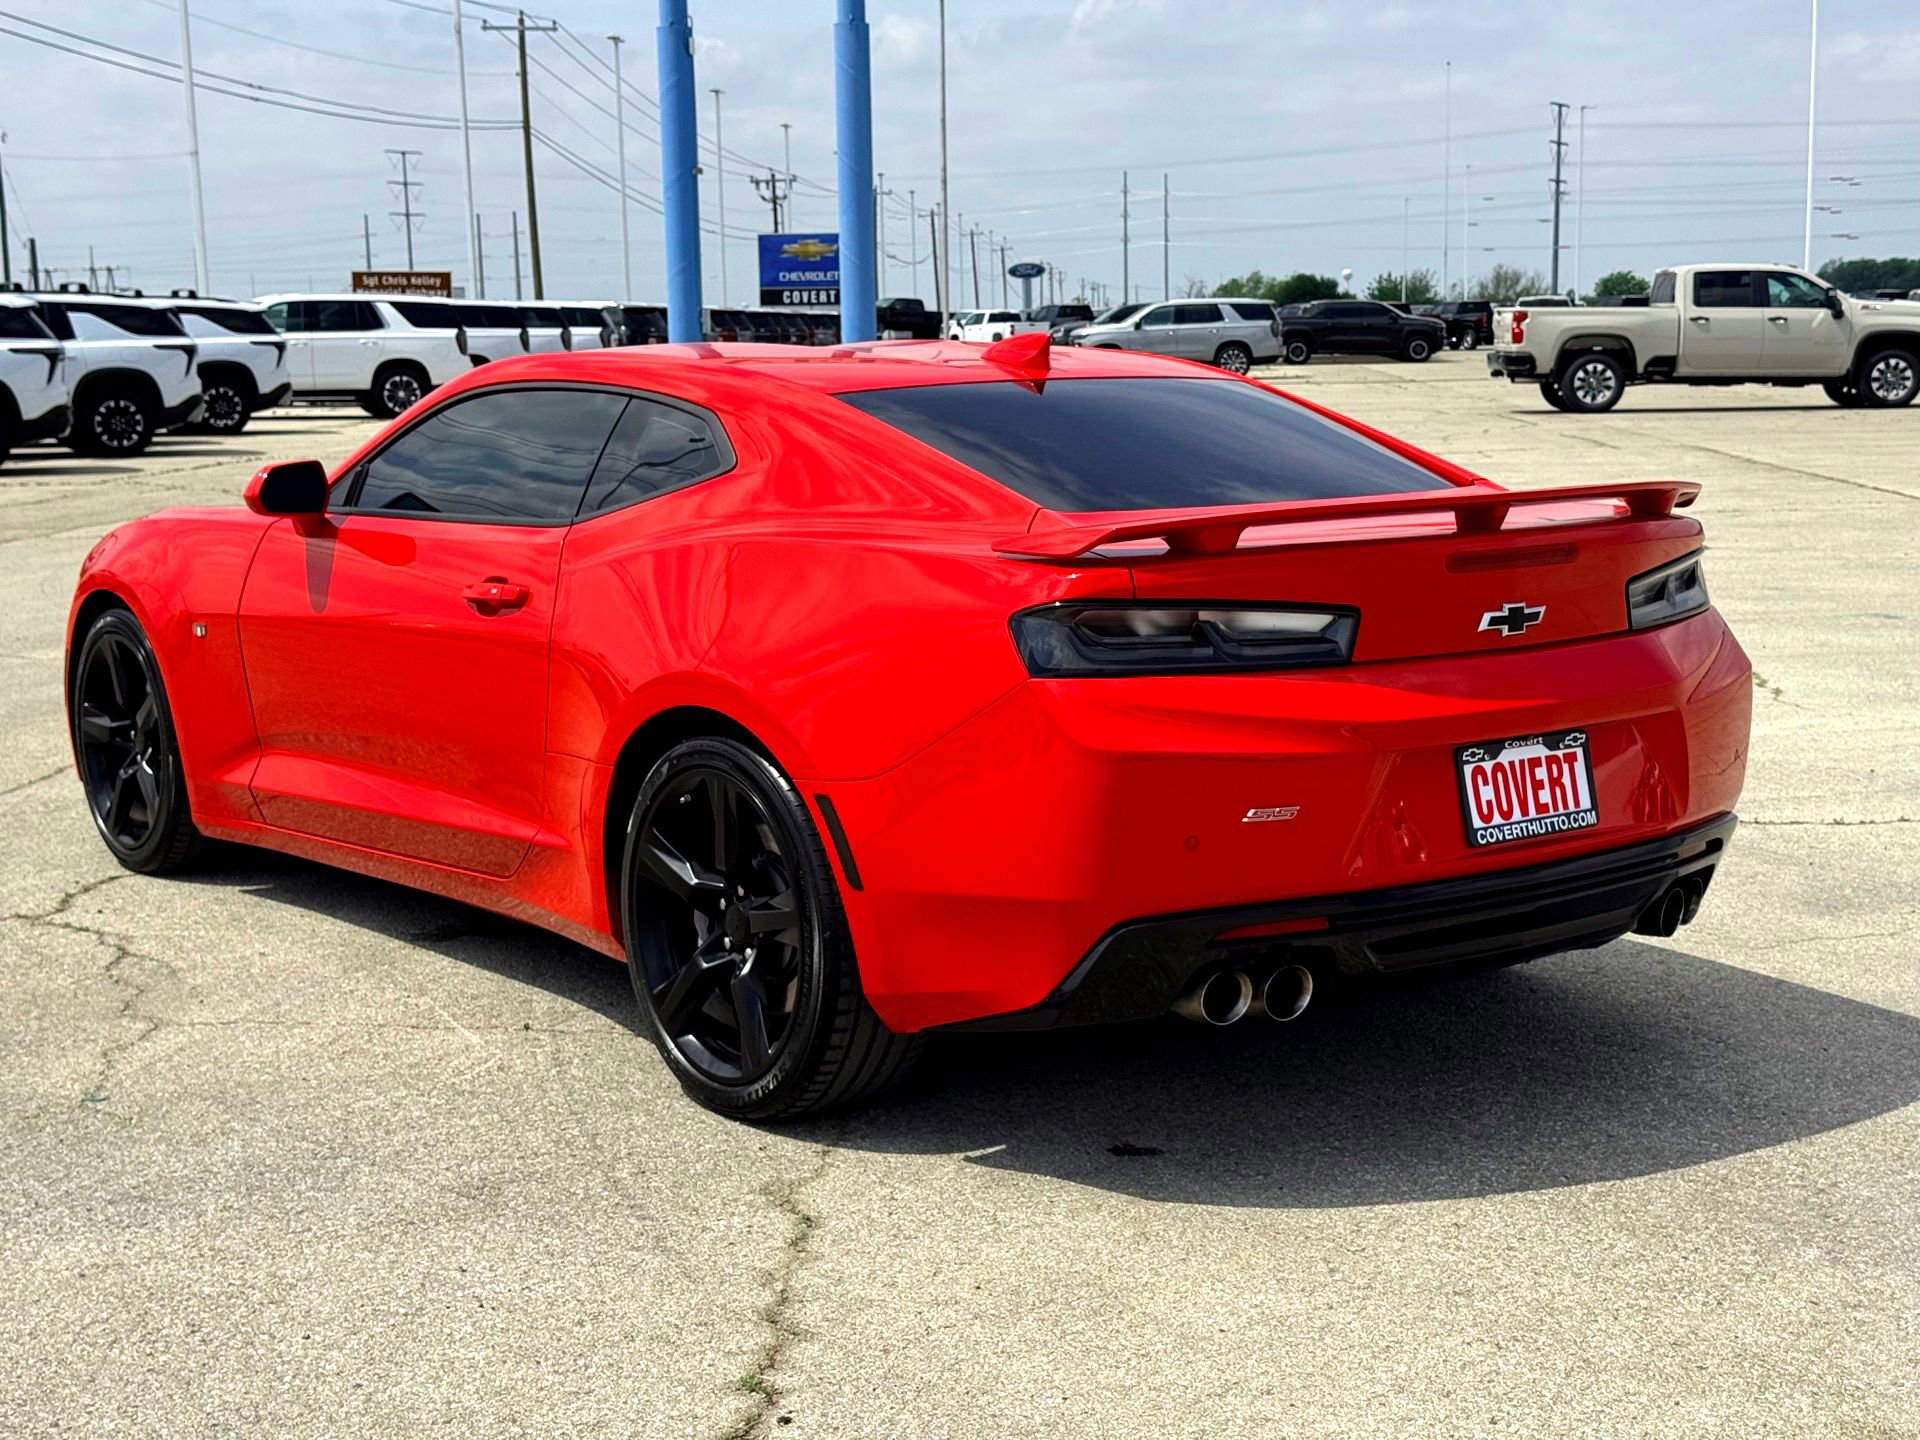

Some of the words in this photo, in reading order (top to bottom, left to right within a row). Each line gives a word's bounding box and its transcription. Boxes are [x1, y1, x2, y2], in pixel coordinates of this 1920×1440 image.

[361, 274, 379, 287] Sgt
[381, 274, 408, 286] Chris
[410, 274, 442, 287] Kelley
[778, 270, 839, 281] CHEVROLET
[782, 290, 837, 304] COVERT
[1504, 736, 1544, 749] Covert
[1470, 751, 1581, 825] COVERT
[1476, 810, 1598, 845] COVERTHUTTO.COM
